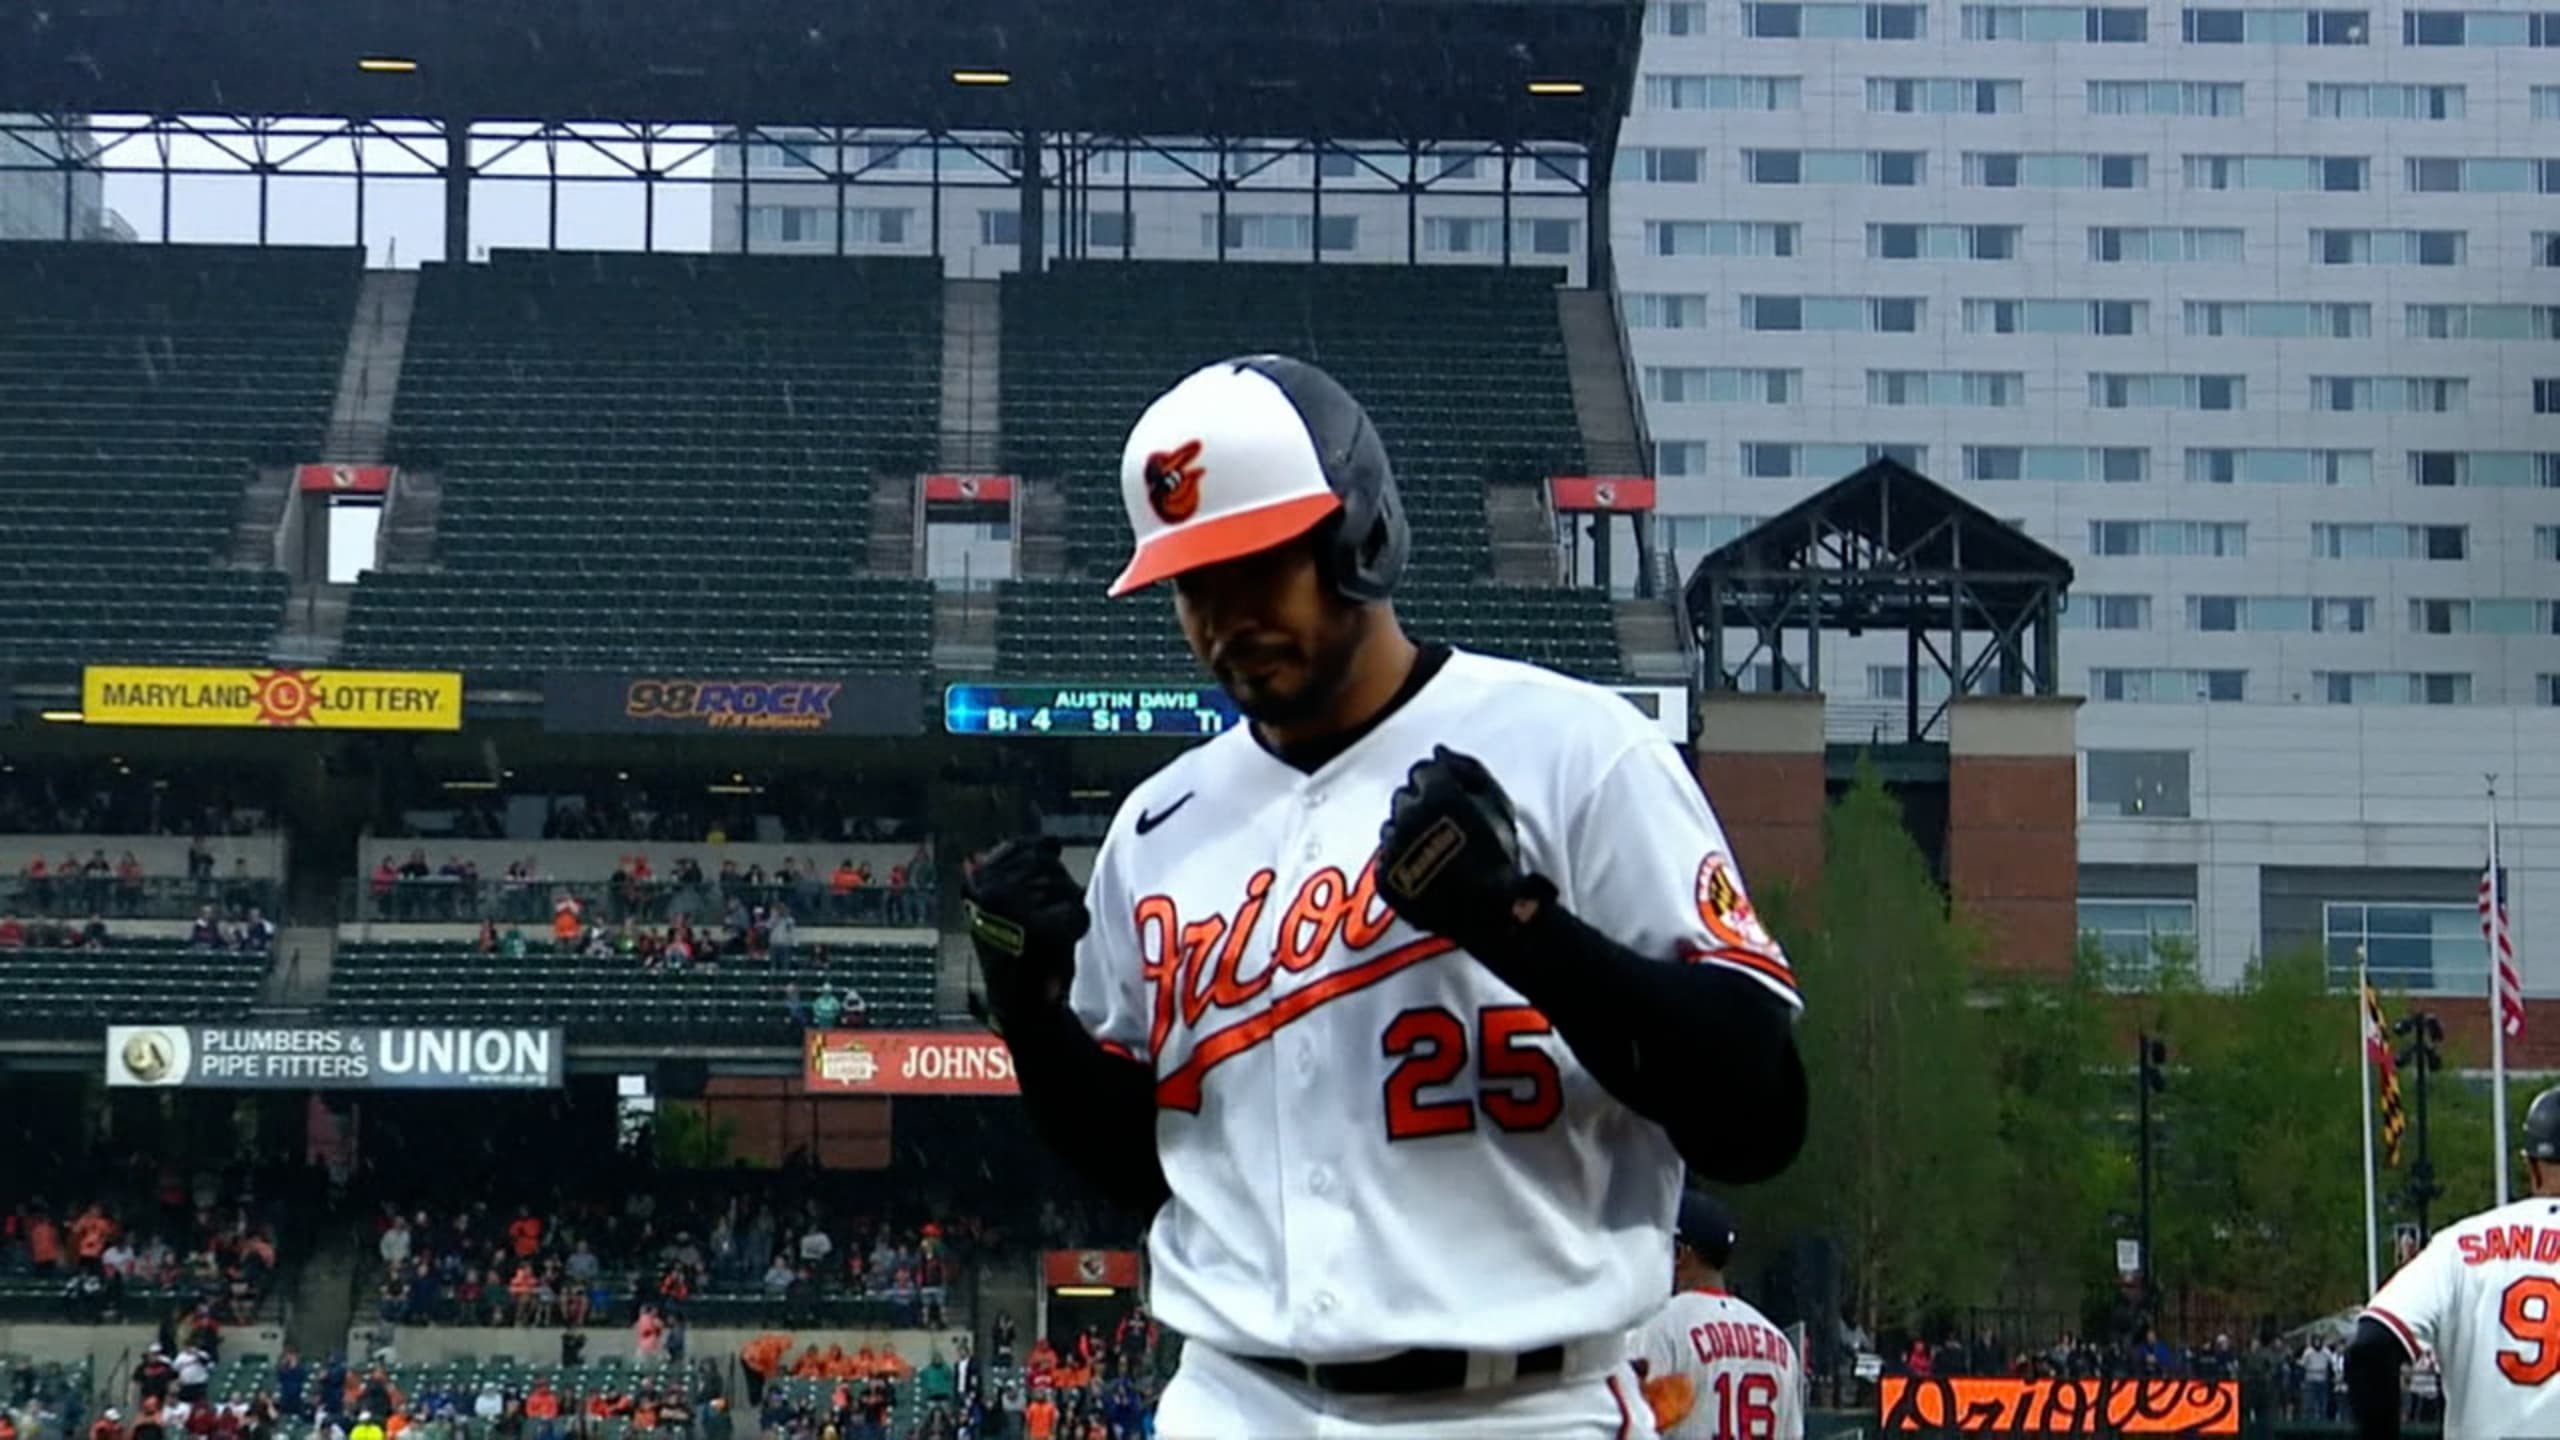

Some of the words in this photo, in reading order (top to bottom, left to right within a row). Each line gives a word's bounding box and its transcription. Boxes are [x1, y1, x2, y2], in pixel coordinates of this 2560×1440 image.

[102, 683, 250, 708] MARYLAND
[320, 686, 440, 712] LOTTERY
[1055, 691, 1133, 709] AUSTIN
[1139, 692, 1199, 710] DAVIS
[1030, 707, 1052, 732] 4
[1135, 709, 1154, 732] 9
[202, 1029, 342, 1052] PLUMBERS
[348, 1037, 367, 1053] &
[378, 1029, 549, 1073] UNION
[201, 1054, 259, 1077] PIPE
[265, 1054, 369, 1079] FITTERS
[902, 1045, 1017, 1079] JOHNS
[1381, 1005, 1565, 1143] 25
[1689, 1321, 1790, 1371] CORDERO
[2496, 1274, 2560, 1386] 9
[1713, 1371, 1779, 1440] 16
